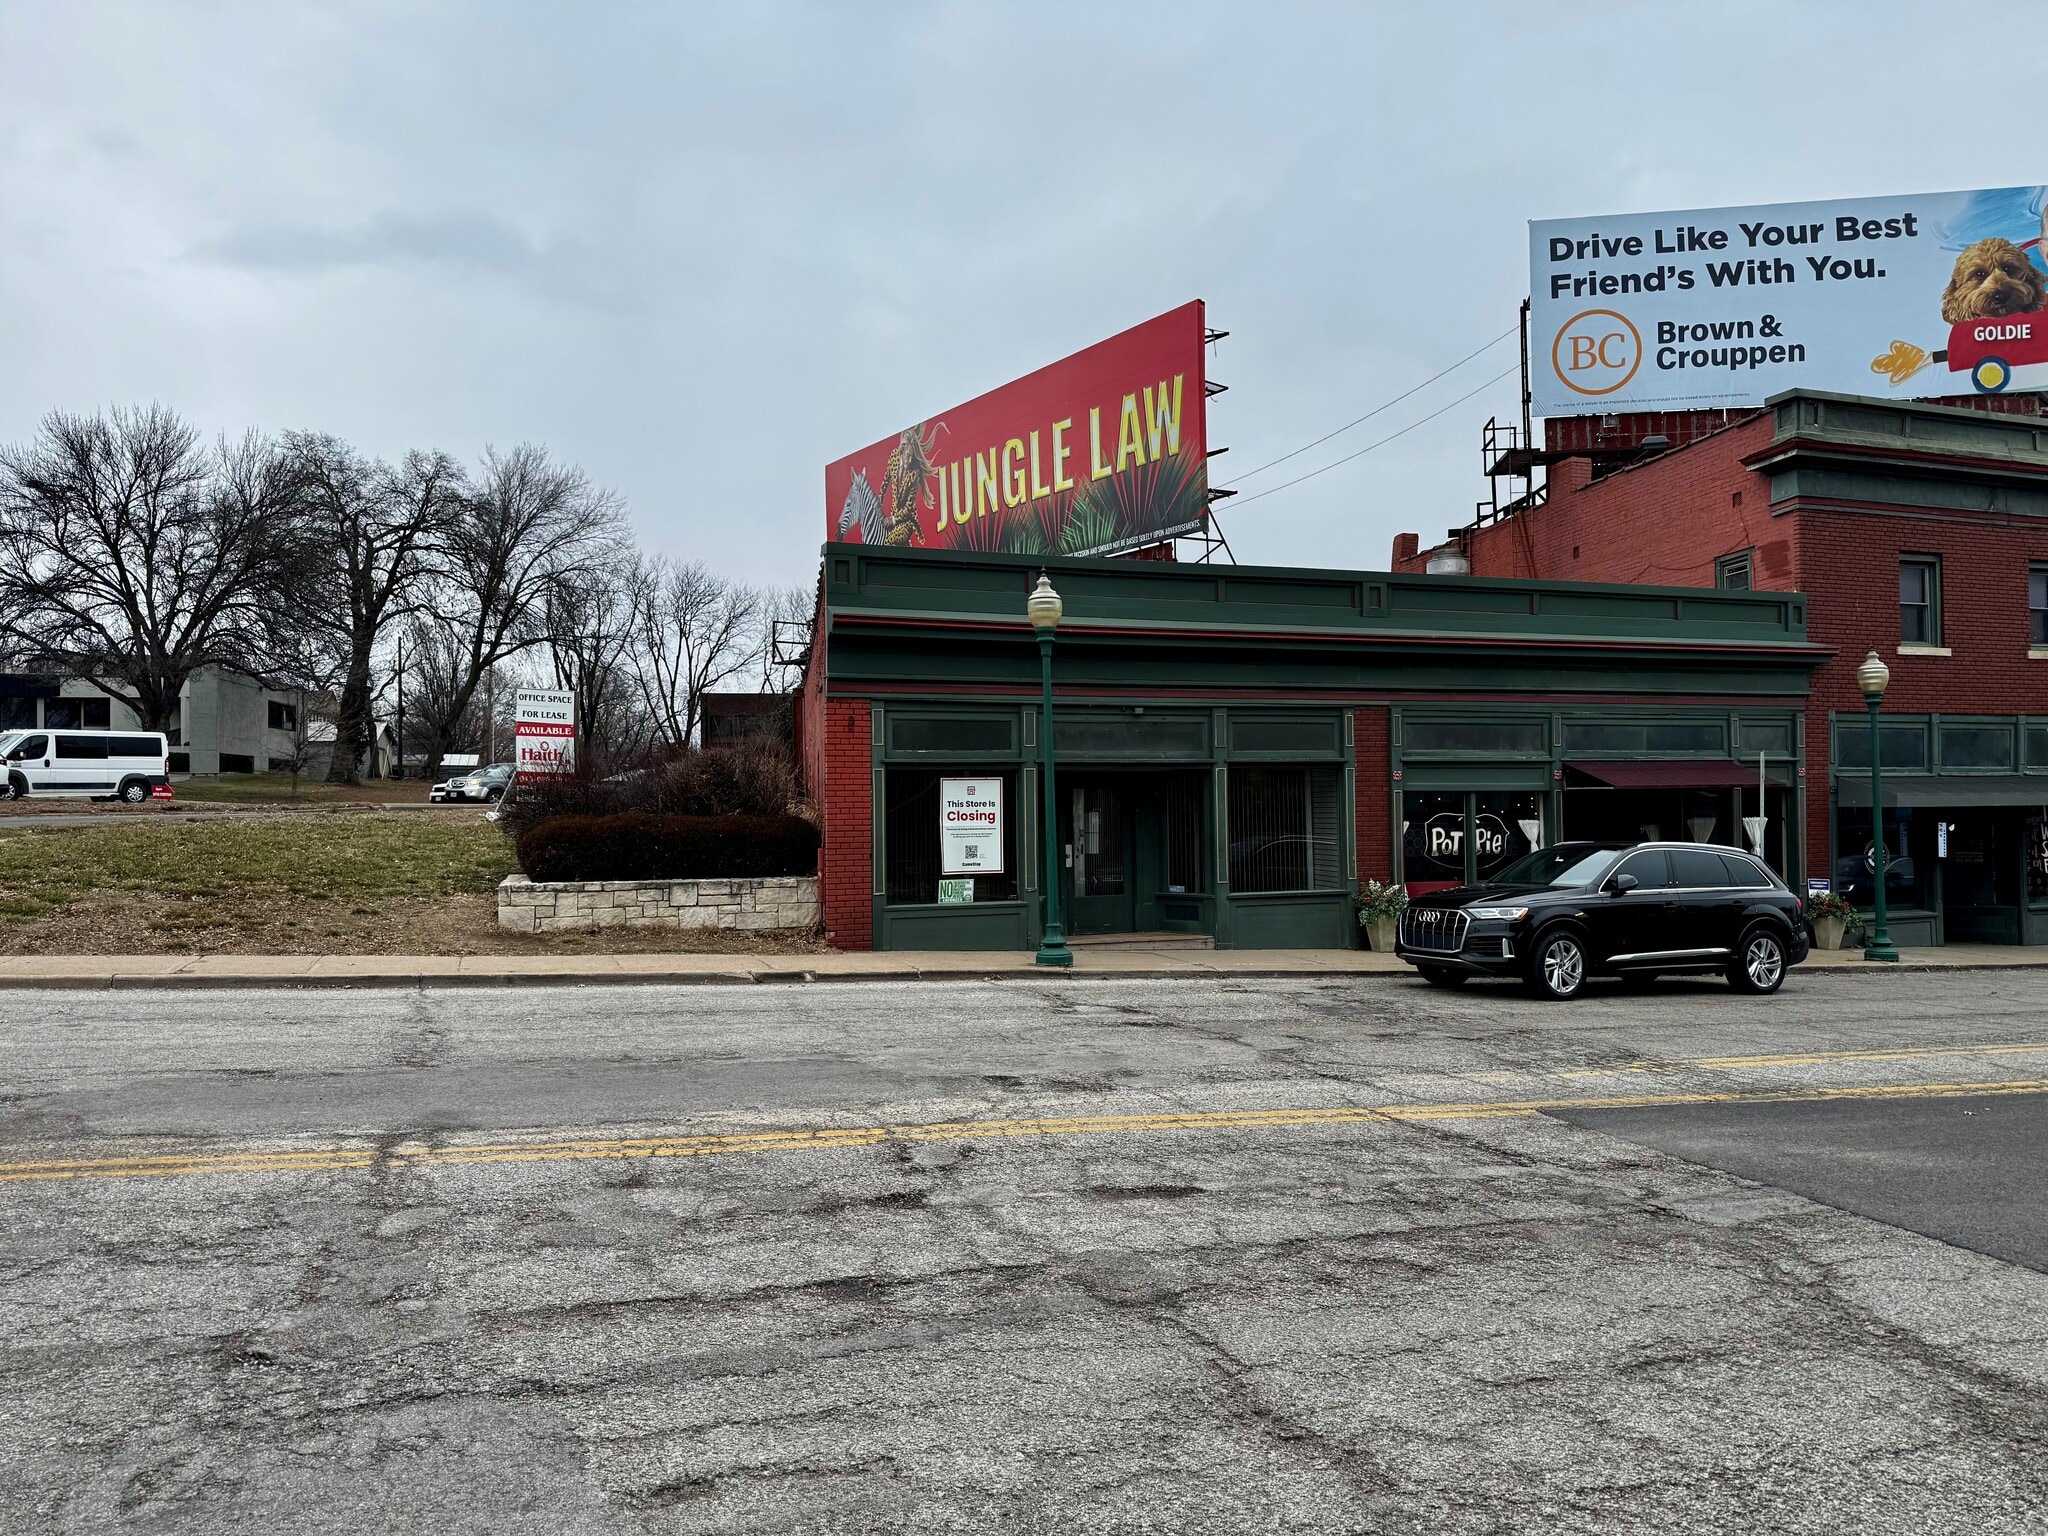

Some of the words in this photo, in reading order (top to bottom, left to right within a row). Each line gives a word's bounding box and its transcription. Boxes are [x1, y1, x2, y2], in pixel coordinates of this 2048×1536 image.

[1550, 233, 1643, 262] Drive
[1655, 226, 1728, 253] Like
[1738, 222, 1824, 247] Your
[1836, 213, 1918, 241] Best
[1551, 266, 1695, 299] Friend's
[1705, 258, 1795, 287] With
[1805, 255, 1886, 281] You.
[1657, 320, 1754, 344] Brown
[1759, 314, 1783, 337] &
[1974, 324, 2031, 341] GOLDIE
[1568, 333, 1626, 371] BC
[1656, 343, 1806, 371] Crouppen
[936, 416, 1074, 533] JUNGLE
[1089, 373, 1185, 482] LAW
[1098, 542, 1112, 552] SHOULD
[1112, 540, 1120, 549] NOT
[1120, 538, 1126, 547] BE
[1126, 535, 1138, 545] BASED
[1138, 531, 1153, 542] SOLELY
[1153, 528, 1164, 538] UPON
[518, 693, 546, 702] OFFICE
[548, 695, 572, 704] SPACE
[522, 710, 539, 718] FOR
[541, 711, 568, 720] LEASE
[518, 726, 572, 735] AVAILABLE
[947, 800, 964, 808] This
[965, 800, 988, 808] Store
[947, 810, 996, 824] Closing
[940, 881, 953, 898] NO
